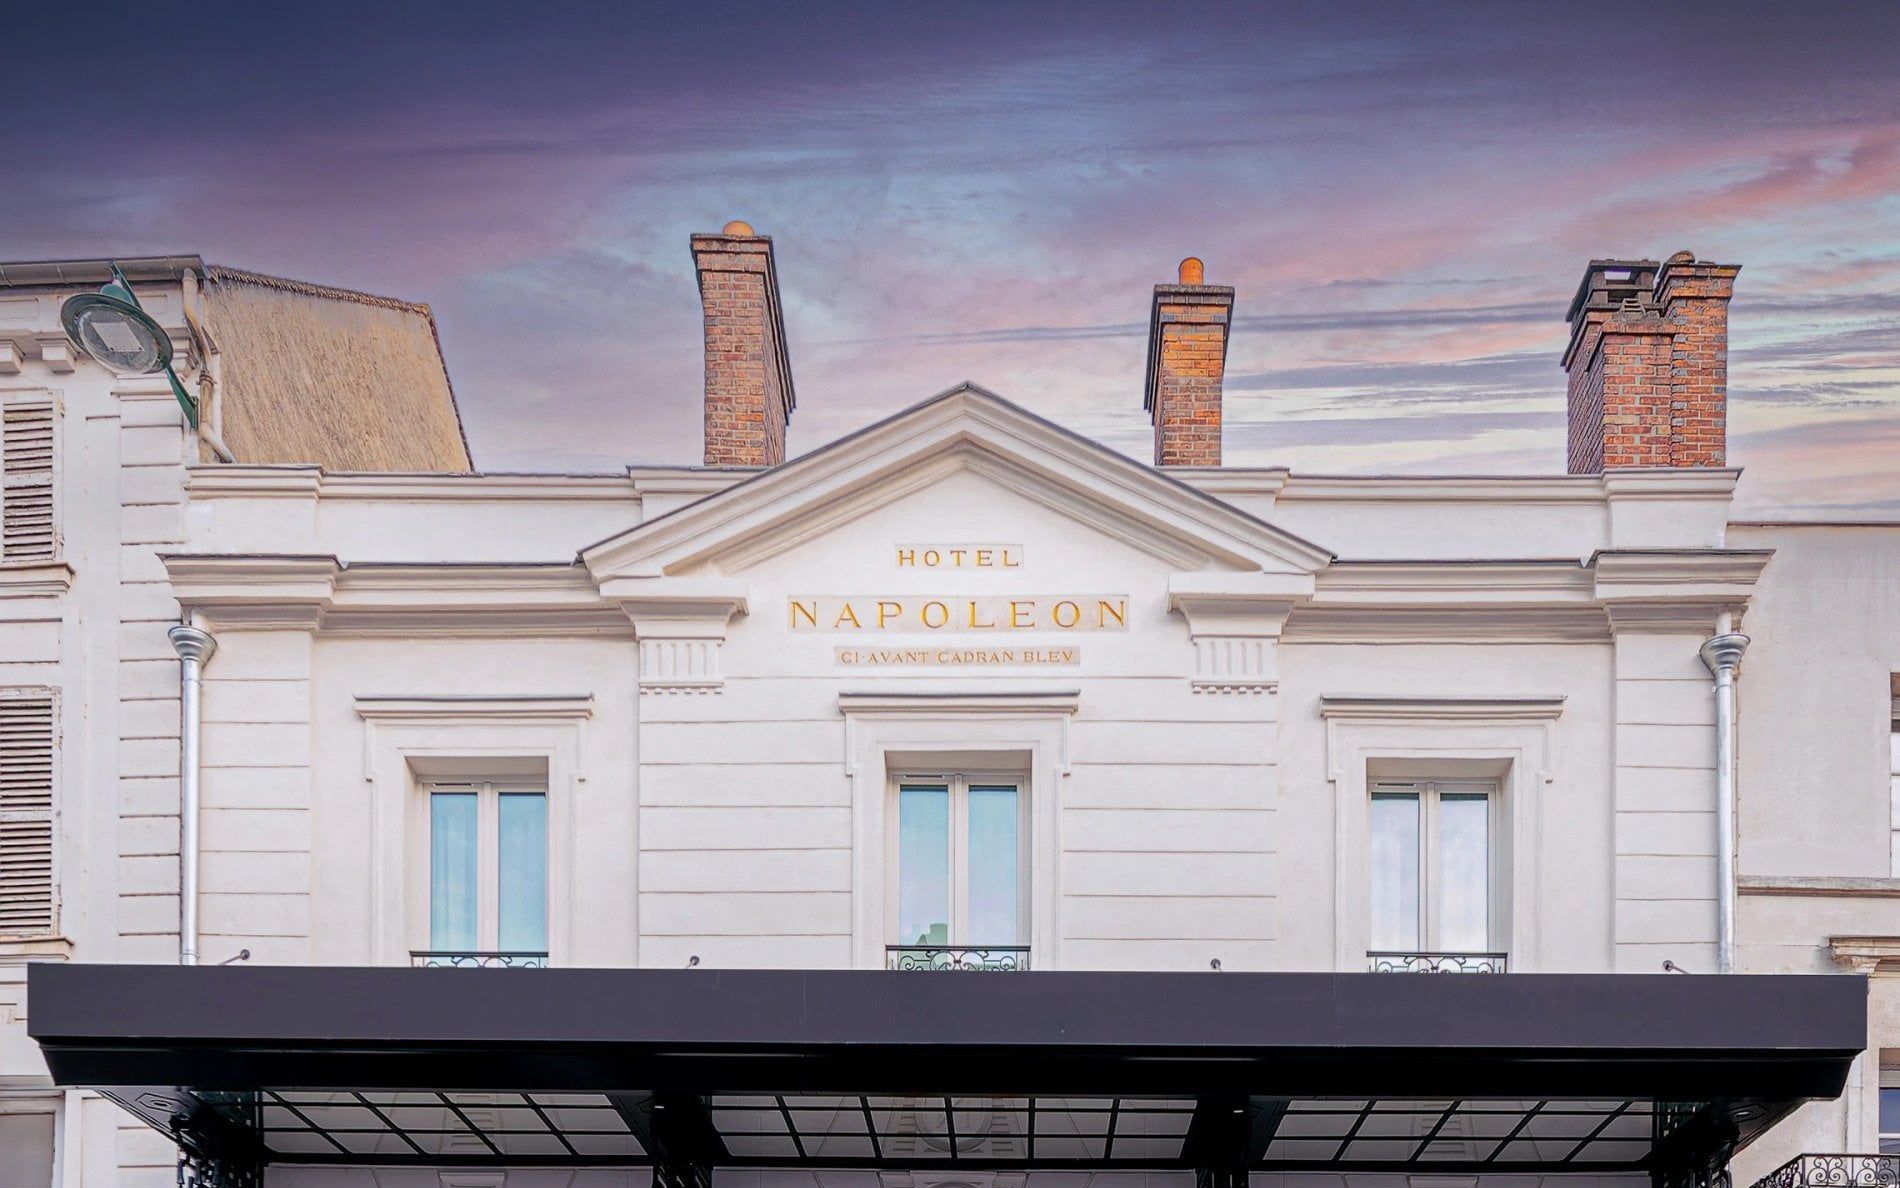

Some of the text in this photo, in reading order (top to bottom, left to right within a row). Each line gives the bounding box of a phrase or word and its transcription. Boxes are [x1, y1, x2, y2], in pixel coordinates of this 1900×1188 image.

[898, 549, 1019, 567] HOTEL
[789, 600, 1126, 630] NAPOLEON
[937, 651, 1014, 664] CADRAN
